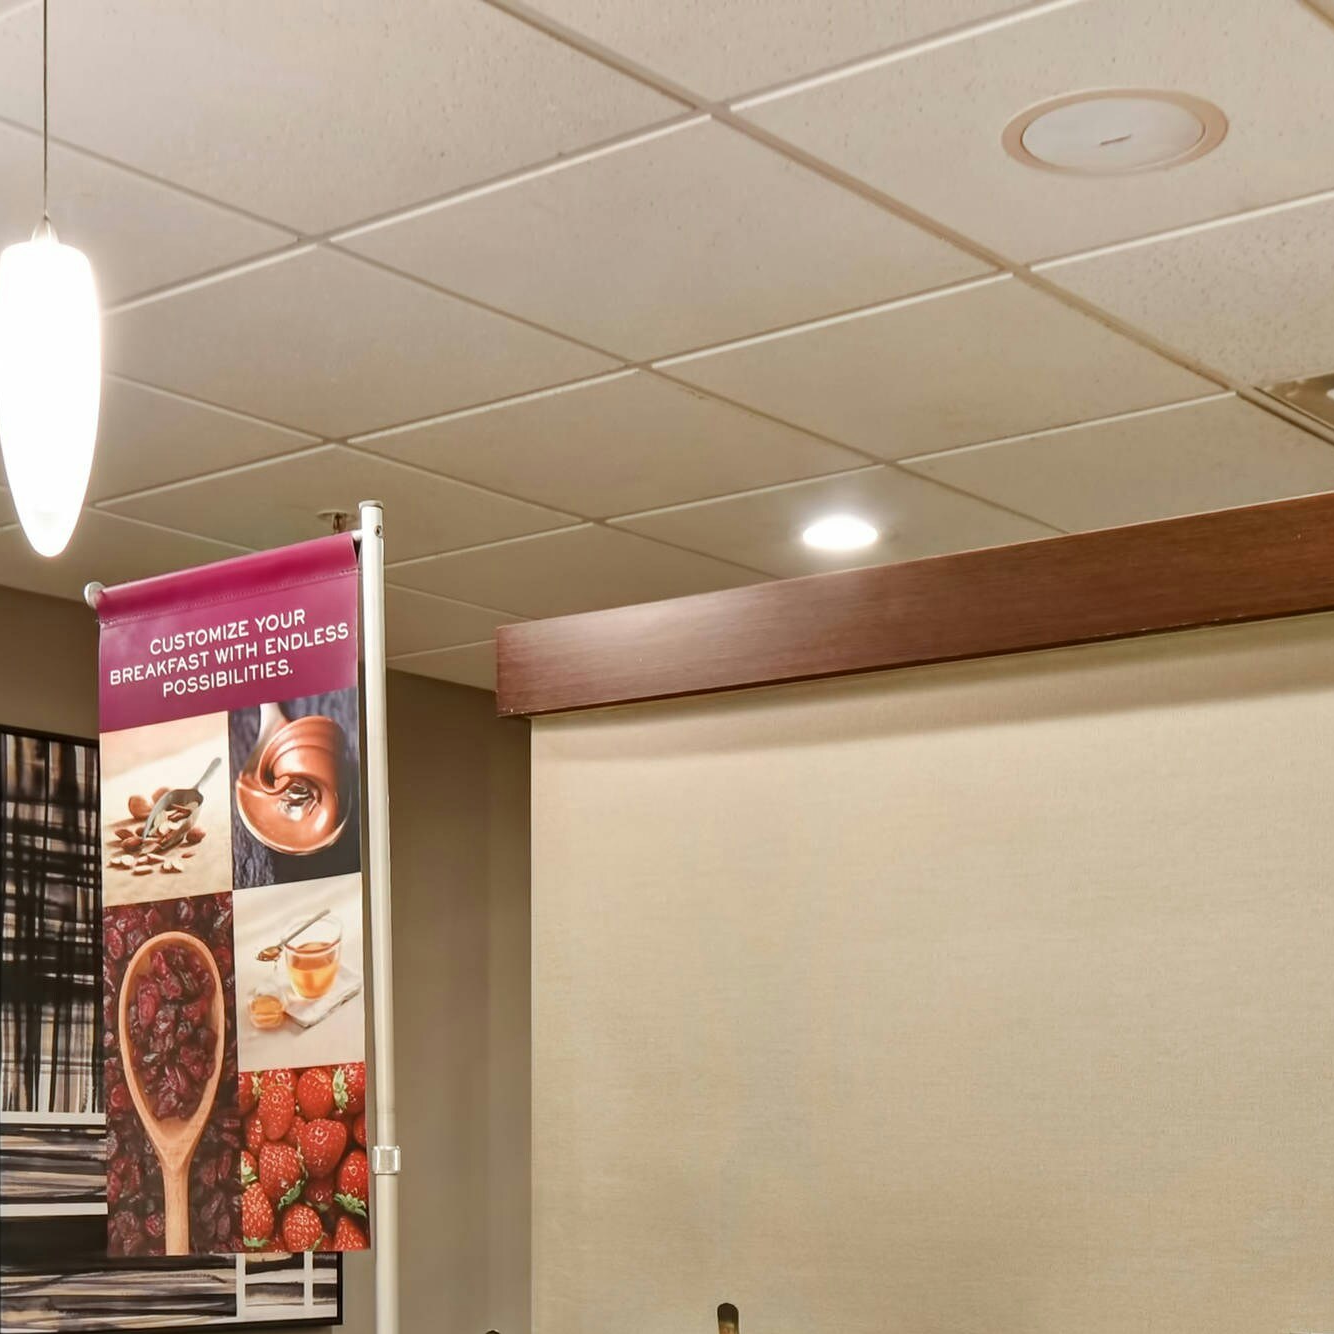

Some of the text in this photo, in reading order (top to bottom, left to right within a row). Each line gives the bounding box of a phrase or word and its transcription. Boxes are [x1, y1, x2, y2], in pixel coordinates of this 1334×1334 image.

[109, 623, 349, 686] BREAKFAST WITH ENDLESS
[149, 608, 306, 655] CUSTOMIZE YOUR
[163, 659, 293, 698] POSSIBILITIES.
